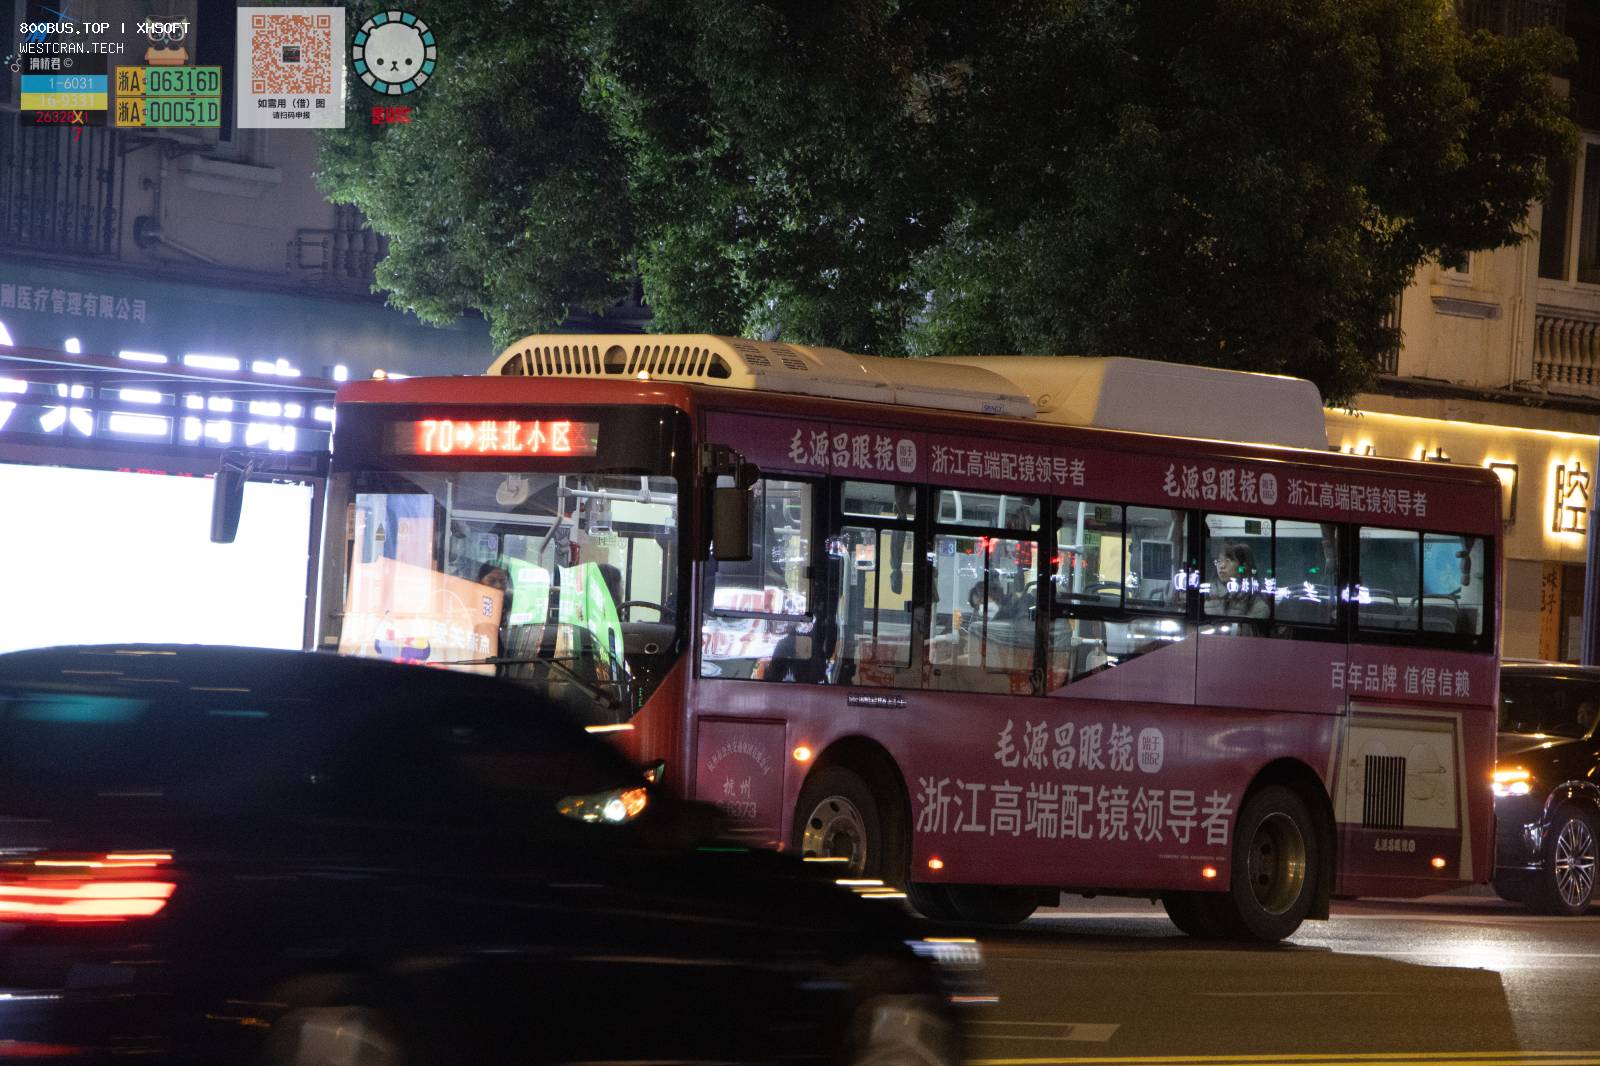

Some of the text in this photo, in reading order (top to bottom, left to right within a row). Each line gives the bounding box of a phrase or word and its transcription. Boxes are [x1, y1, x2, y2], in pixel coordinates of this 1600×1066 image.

[788, 428, 894, 472] 毛源昌眼镜
[931, 445, 1087, 487] 浙江高端配镜领导者
[1162, 463, 1258, 504] 毛源昌眼镜
[1287, 478, 1428, 518] 浙江高端配镜领导者
[1330, 661, 1470, 698] 百年品牌 值得信赖
[994, 719, 1135, 773] 毛源昌眼镜
[916, 776, 1233, 846] 浙江高端配镜领导者
